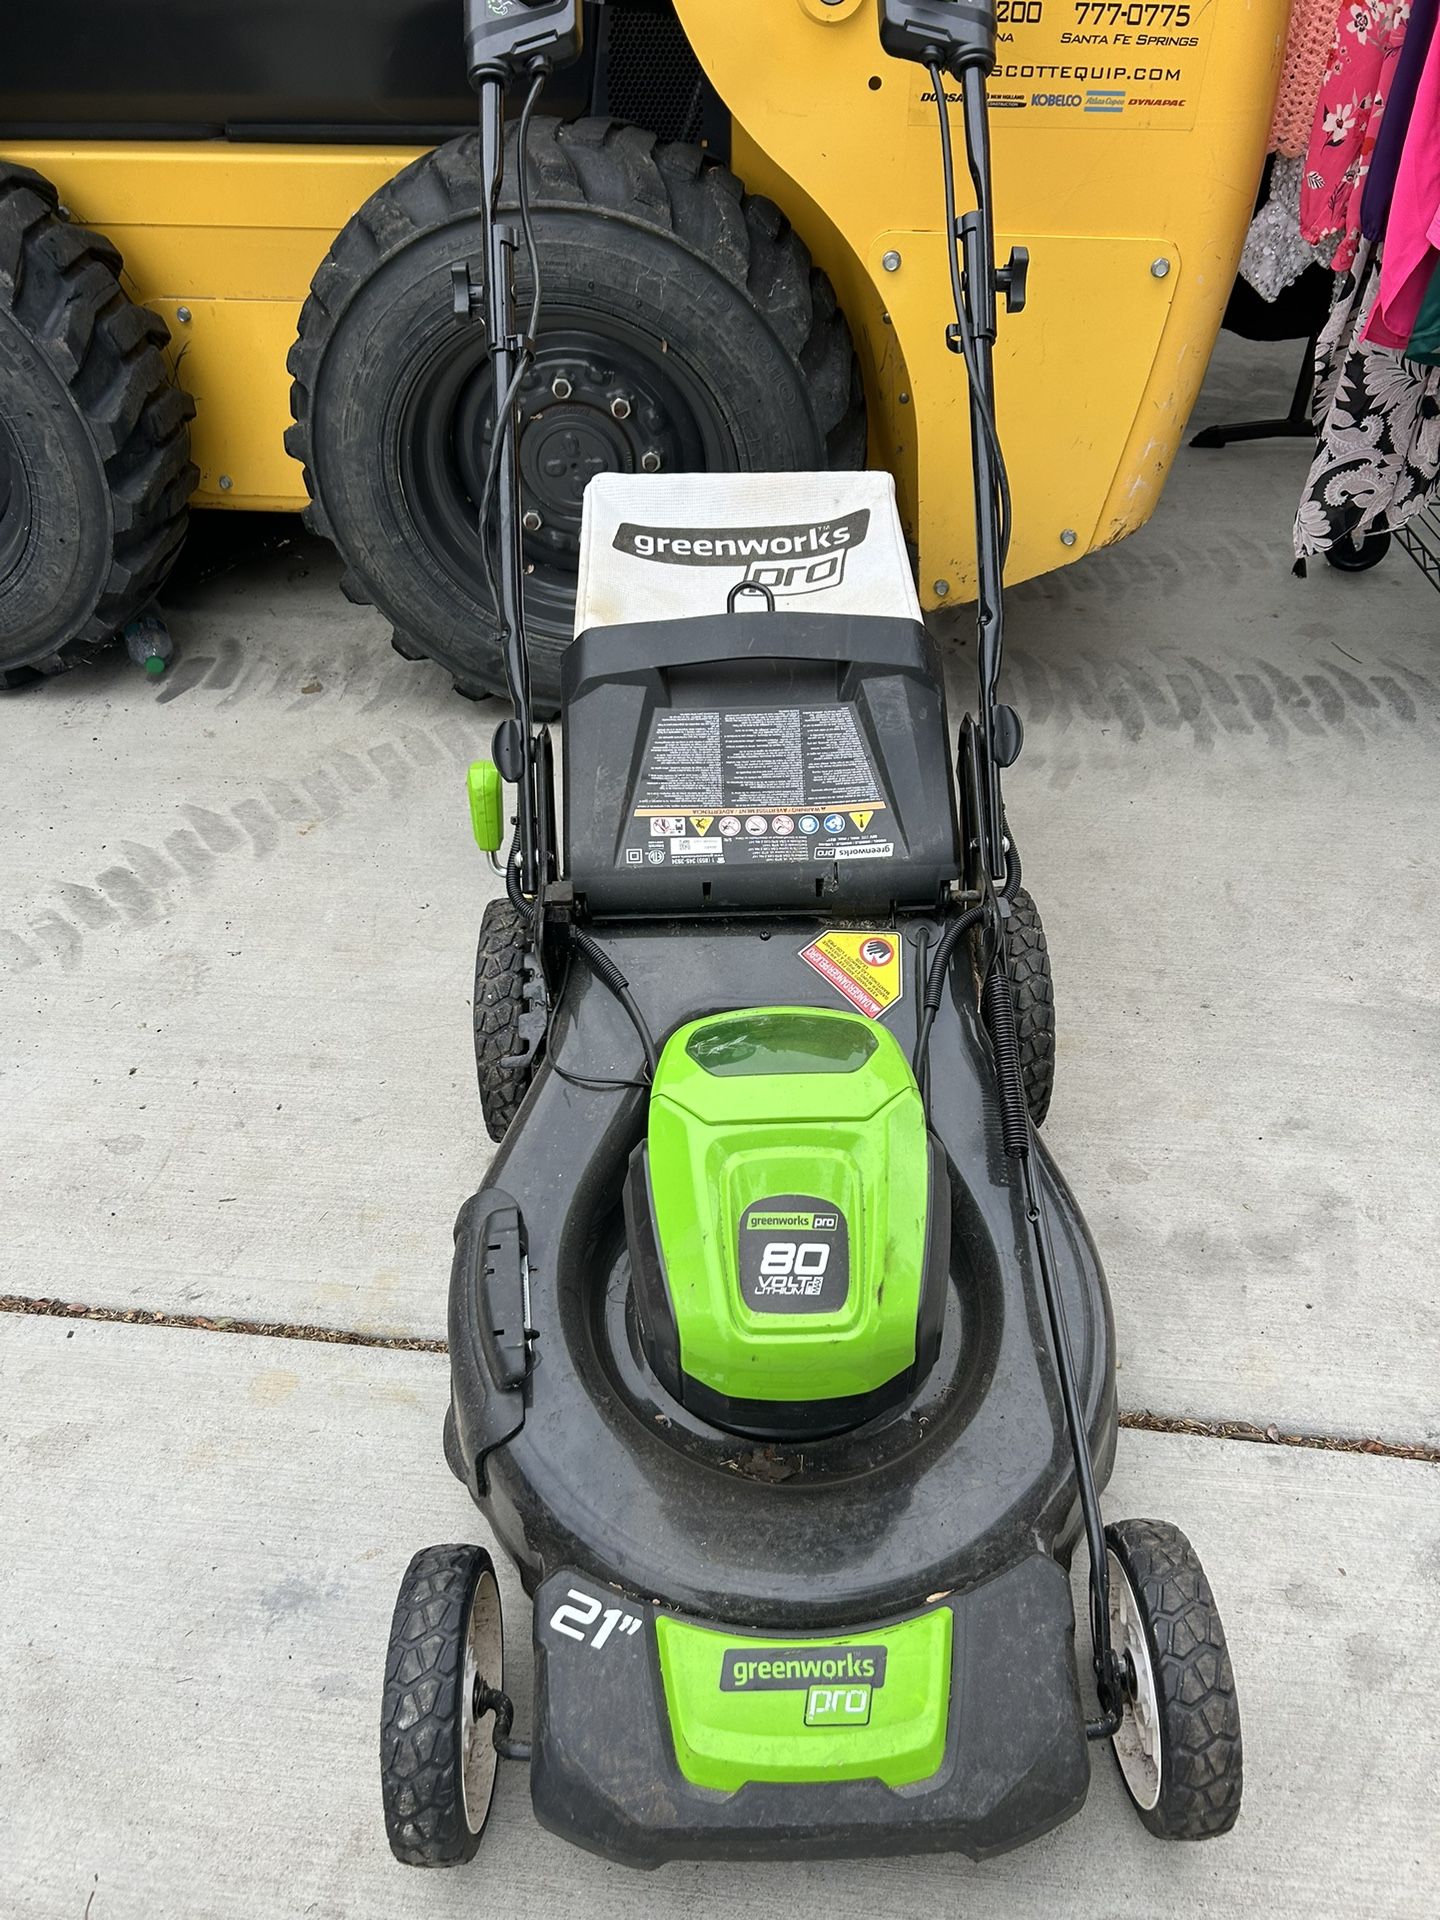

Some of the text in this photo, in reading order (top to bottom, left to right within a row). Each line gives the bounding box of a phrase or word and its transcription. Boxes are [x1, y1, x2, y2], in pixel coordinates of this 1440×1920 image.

[996, 1, 1191, 27] 200 777-0775
[991, 65, 1181, 81] SCOTTEQUIP.COM
[920, 92, 963, 102] DOSA
[1031, 93, 1082, 107] KOBELCO
[1128, 98, 1187, 107] DYNAPAC
[747, 558, 837, 594] pro
[839, 845, 890, 856] greenworks
[828, 964, 852, 988] DANGER
[848, 983, 873, 1007] DANGER
[751, 1215, 835, 1229] greenworks pro
[760, 1242, 830, 1275] 80
[757, 1276, 813, 1288] VOLT
[754, 1286, 804, 1295] LITHIUM
[733, 1651, 875, 1686] greenworks
[809, 1688, 868, 1721] pro
